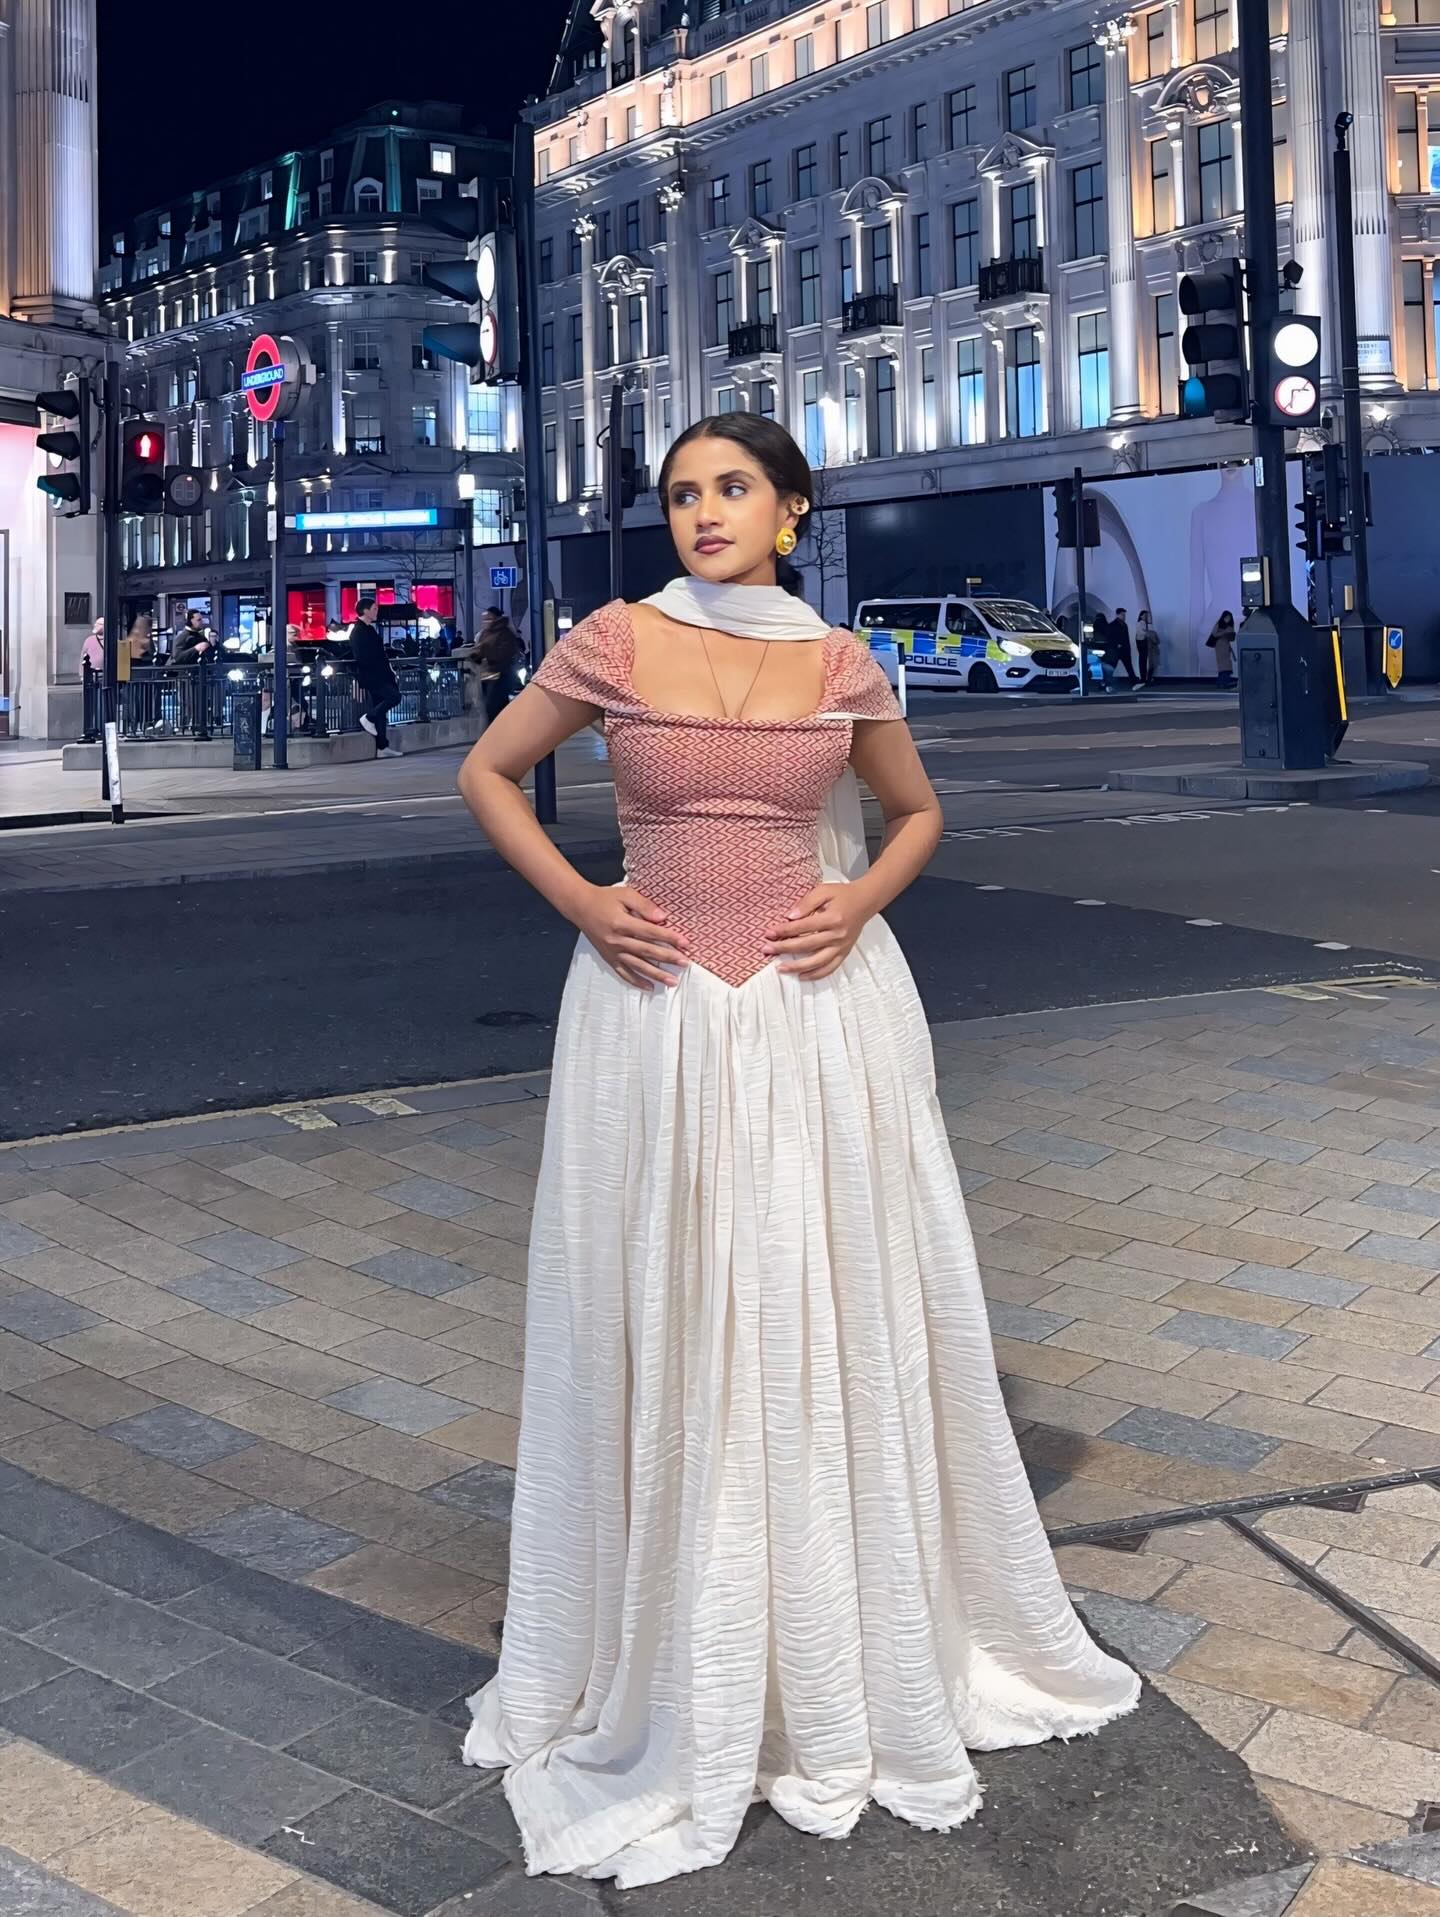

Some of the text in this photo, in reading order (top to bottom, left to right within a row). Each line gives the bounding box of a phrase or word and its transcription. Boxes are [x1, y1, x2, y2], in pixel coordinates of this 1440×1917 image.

[243, 368, 284, 388] UNDERGROUND
[904, 655, 958, 667] POLICE
[939, 826, 1056, 842] LEF
